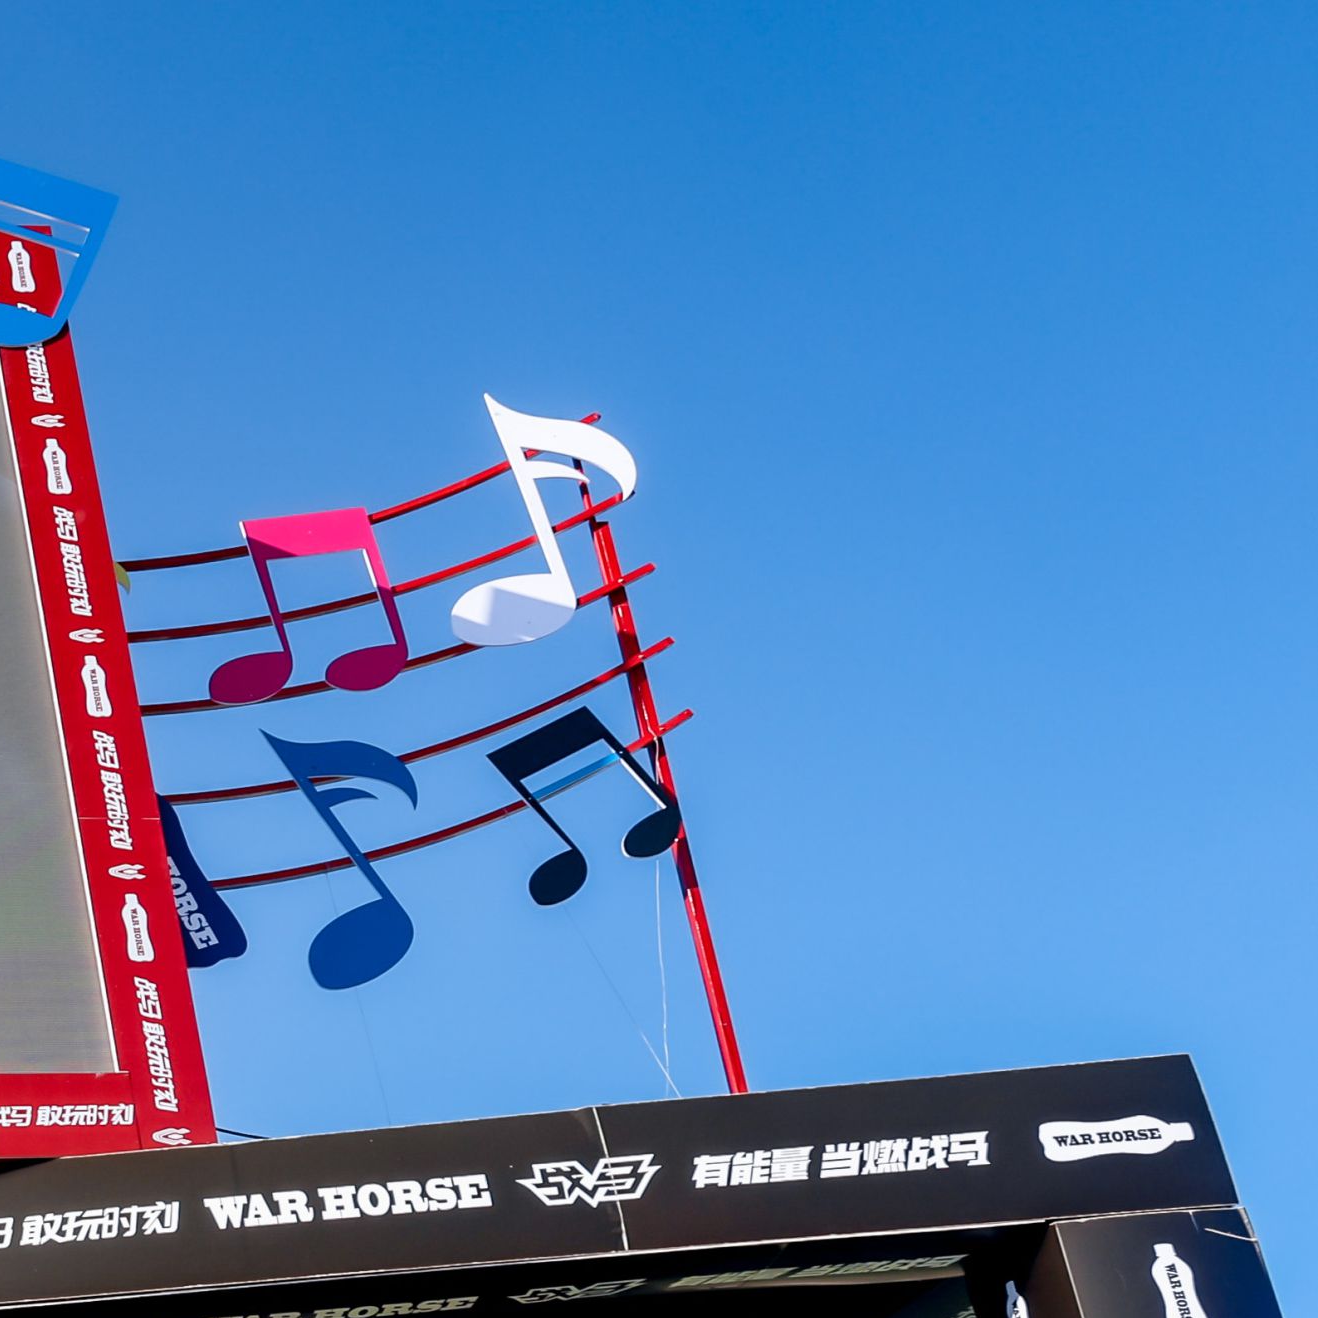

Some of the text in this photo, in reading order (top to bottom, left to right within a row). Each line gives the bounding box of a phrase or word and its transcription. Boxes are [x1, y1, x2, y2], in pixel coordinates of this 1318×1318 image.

[88, 667, 104, 712] WAR HORSE
[93, 731, 119, 769] 战马
[128, 907, 146, 958] WAR HORSE
[134, 977, 162, 1019] 战马
[36, 1104, 134, 1126] 敢玩时刻
[1054, 1127, 1163, 1149] WAR HORSE
[20, 1202, 179, 1245] 敢玩时刻
[204, 1191, 313, 1229] WAR
[318, 1174, 492, 1220] HORSE
[692, 1146, 814, 1188] 有能量
[820, 1131, 990, 1178] 当燃战马
[1164, 1262, 1183, 1292] WAR
